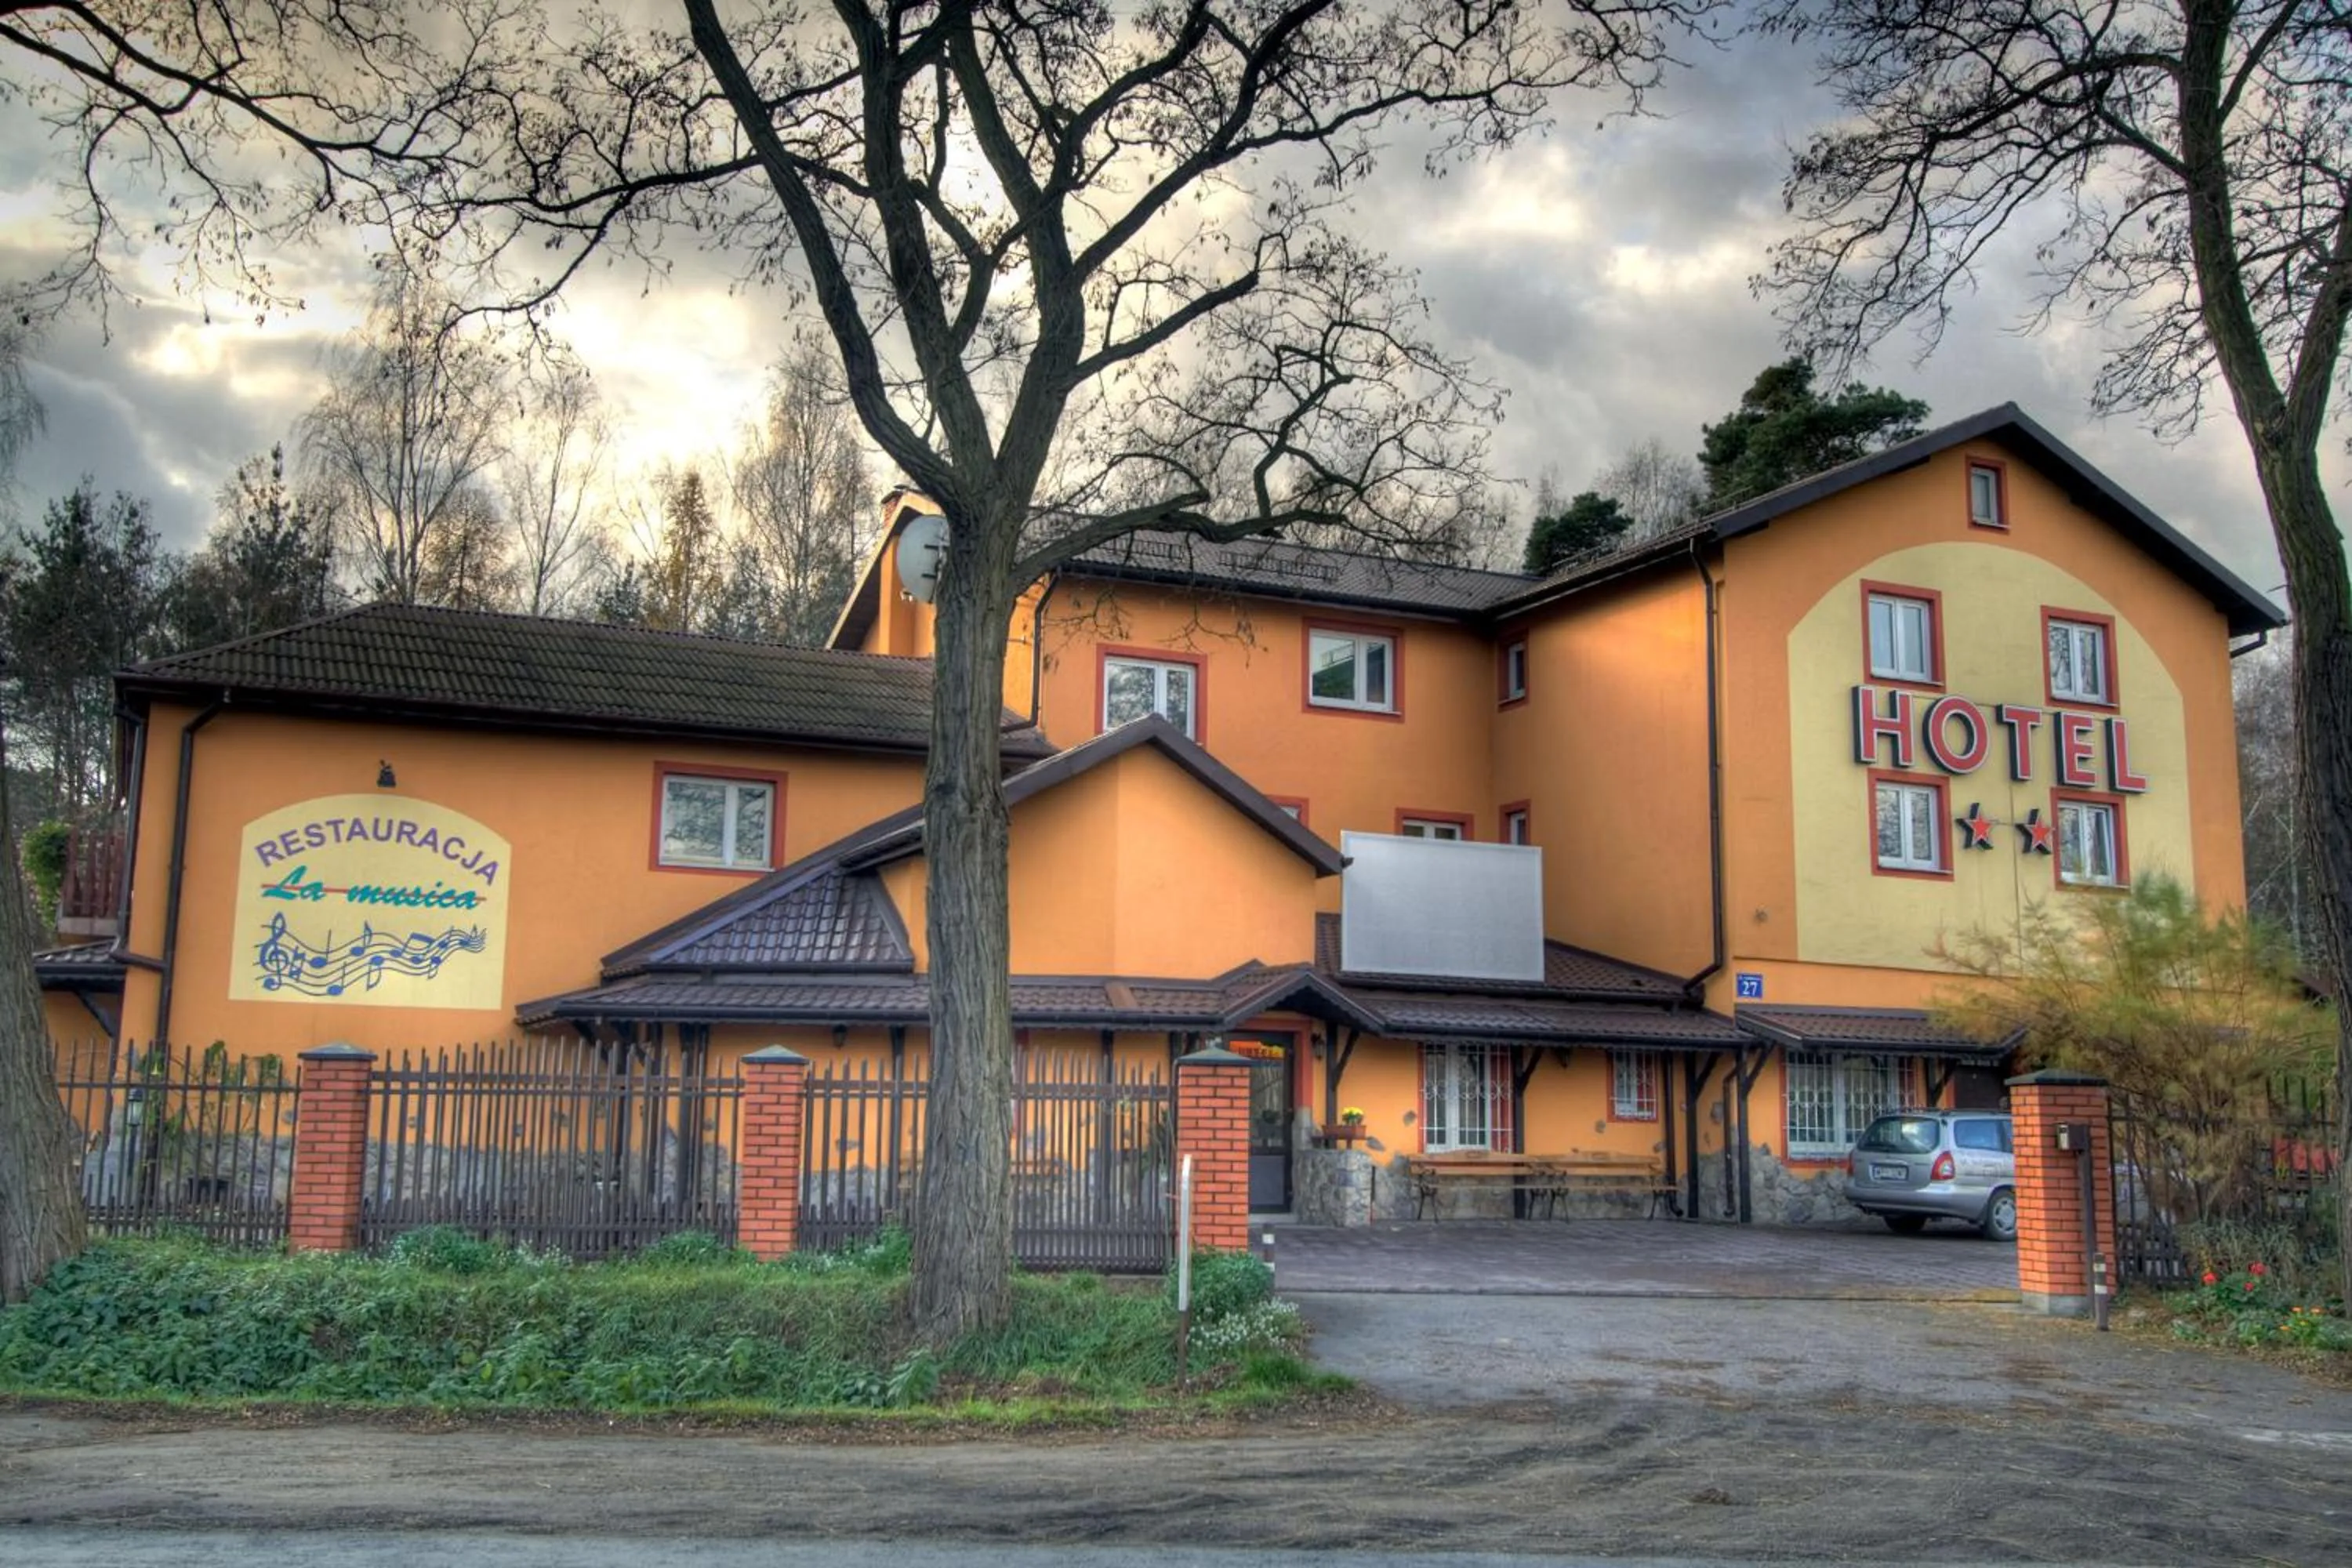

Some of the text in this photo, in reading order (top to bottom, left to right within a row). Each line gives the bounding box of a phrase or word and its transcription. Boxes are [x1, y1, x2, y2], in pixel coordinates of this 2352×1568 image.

[1852, 685, 2147, 793] HOTEL
[255, 818, 499, 886] RESTAURACJA
[261, 865, 481, 909] La musica
[1743, 981, 1758, 996] 27
